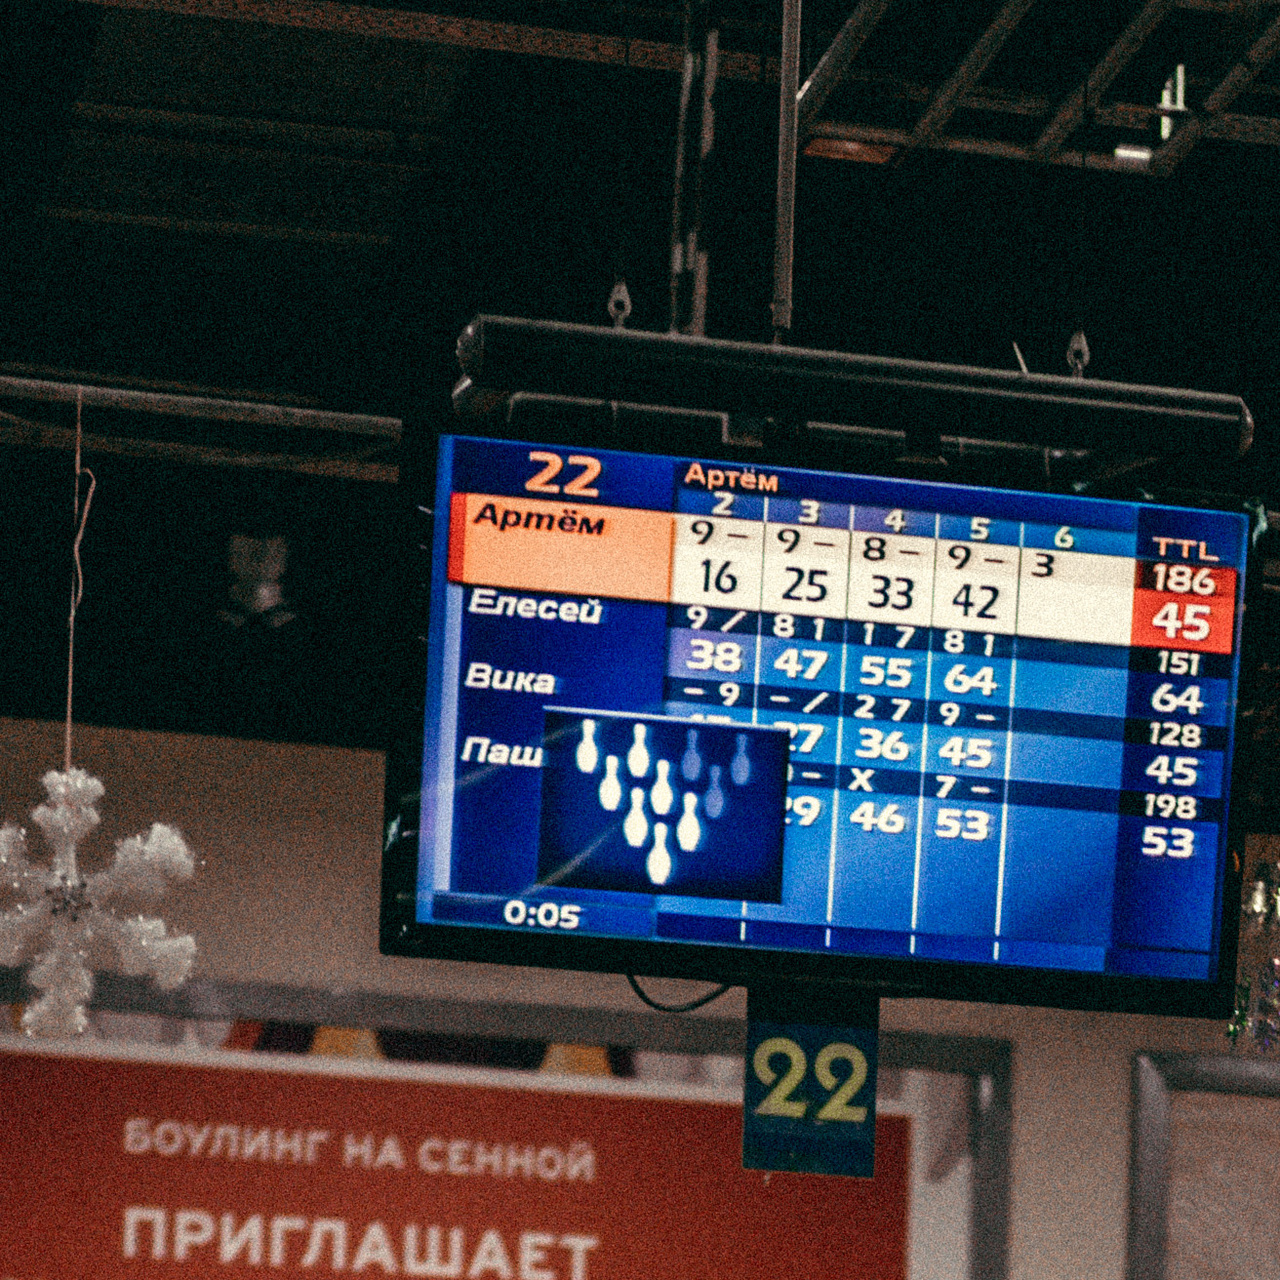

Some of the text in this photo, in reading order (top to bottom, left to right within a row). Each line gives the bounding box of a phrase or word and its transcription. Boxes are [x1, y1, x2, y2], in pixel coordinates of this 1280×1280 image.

[524, 451, 602, 497] 22
[684, 462, 778, 492] Артём
[474, 503, 605, 535] Артём
[1031, 553, 1055, 577] 3
[1152, 563, 1216, 595] 186
[712, 491, 1219, 562] 2 3 4 5 6 TTL
[701, 559, 1212, 641] 16 25 33 42 45
[685, 638, 1204, 715] 38 47 55 64 64
[1158, 650, 1201, 677] 151
[464, 661, 556, 695] Вика
[1150, 721, 1202, 748] 128
[855, 727, 909, 761] 36
[938, 736, 993, 769] 45
[1145, 754, 1200, 787] 45
[850, 801, 905, 834] 46
[935, 808, 990, 841] 53
[1142, 825, 1195, 858] 53
[1145, 793, 1197, 820] 198
[503, 899, 582, 930] 0:05
[752, 1037, 868, 1123] 22
[123, 1117, 597, 1184] БОУЛИНГ НА СЕННОЙ
